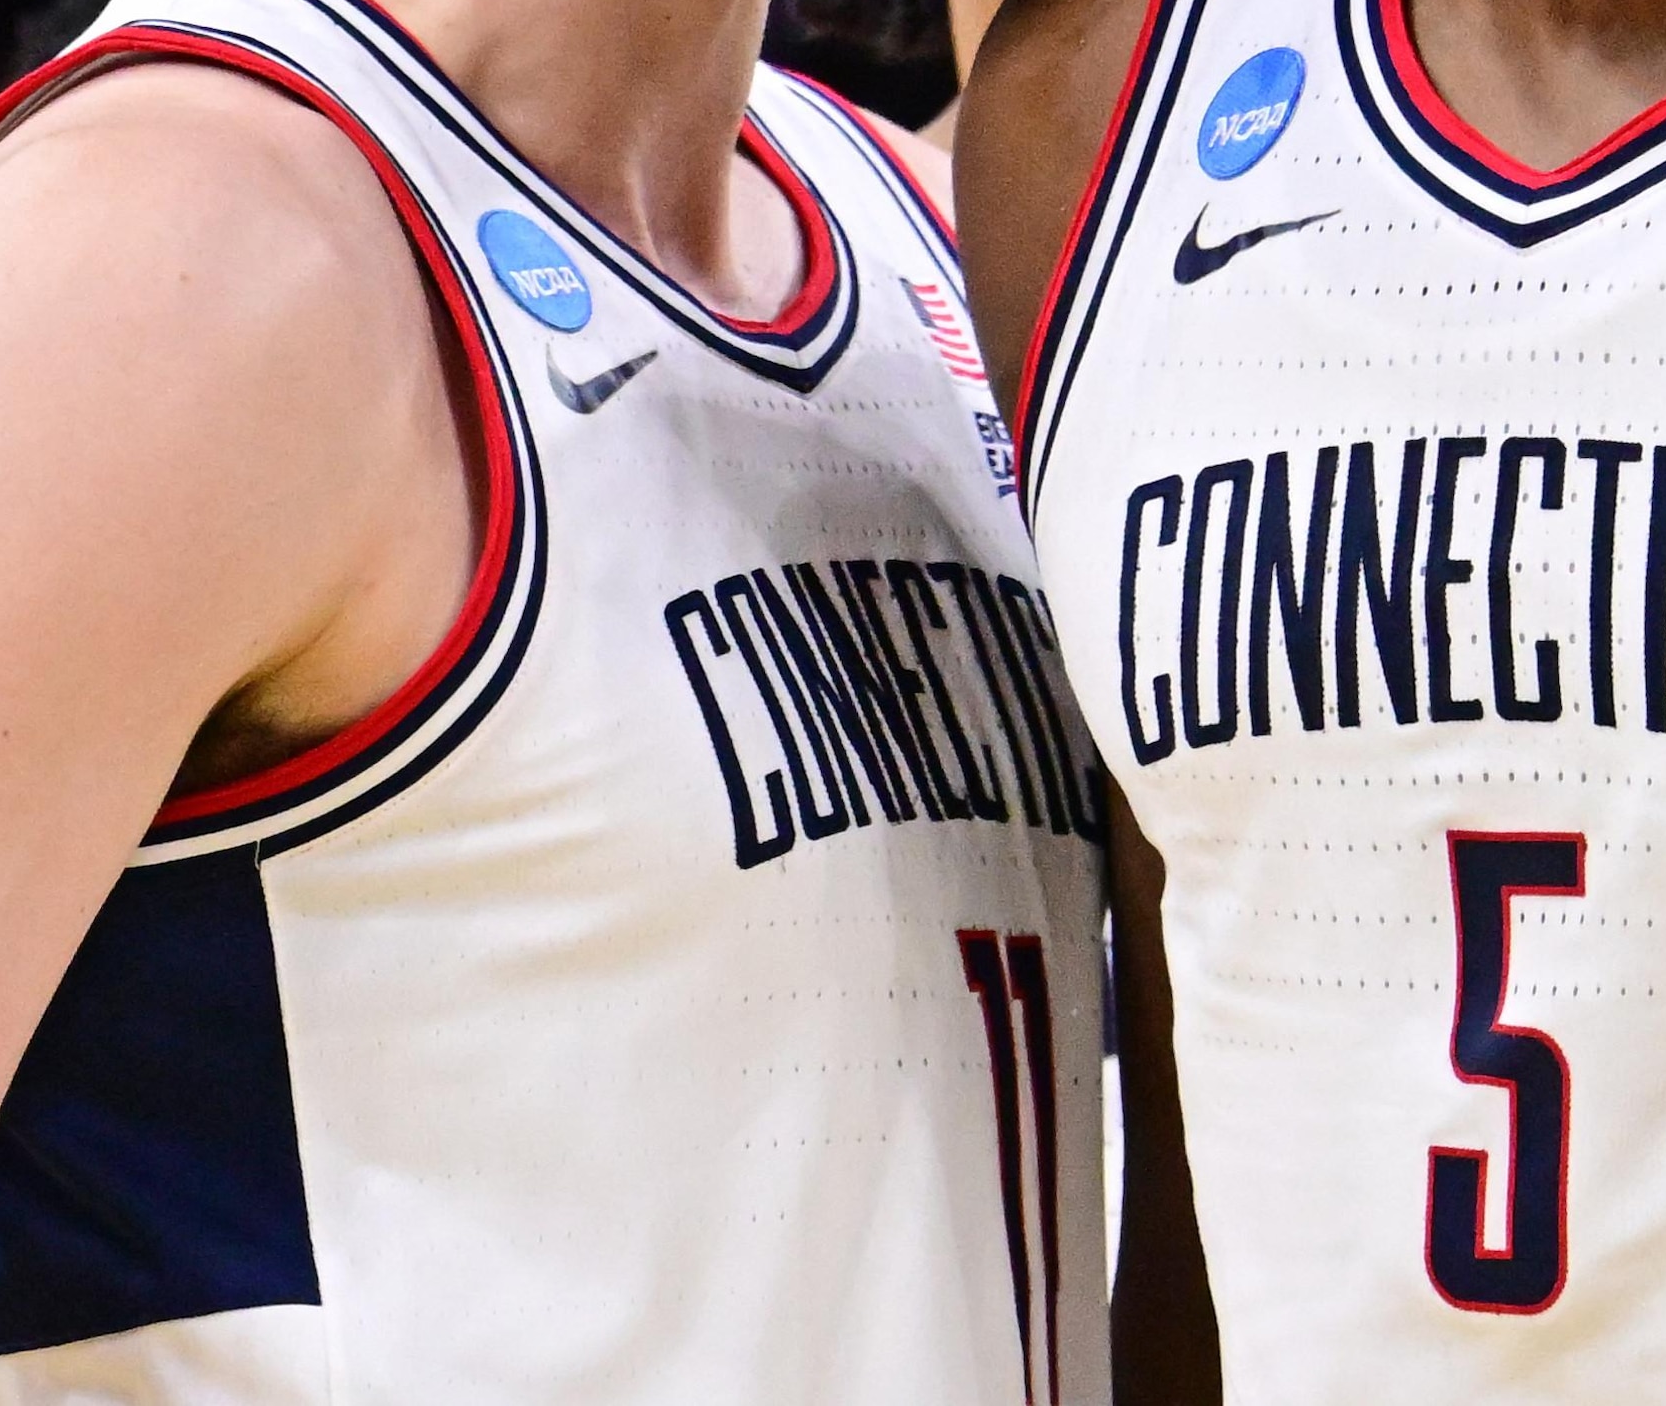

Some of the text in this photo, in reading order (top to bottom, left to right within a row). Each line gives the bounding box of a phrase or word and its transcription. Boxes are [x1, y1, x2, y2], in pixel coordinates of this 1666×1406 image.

[1208, 99, 1290, 148] NCAA
[509, 266, 586, 299] NCAA
[664, 559, 1109, 871] CONNECTIC
[955, 929, 1060, 1406] 11
[1425, 830, 1586, 1315] 5
